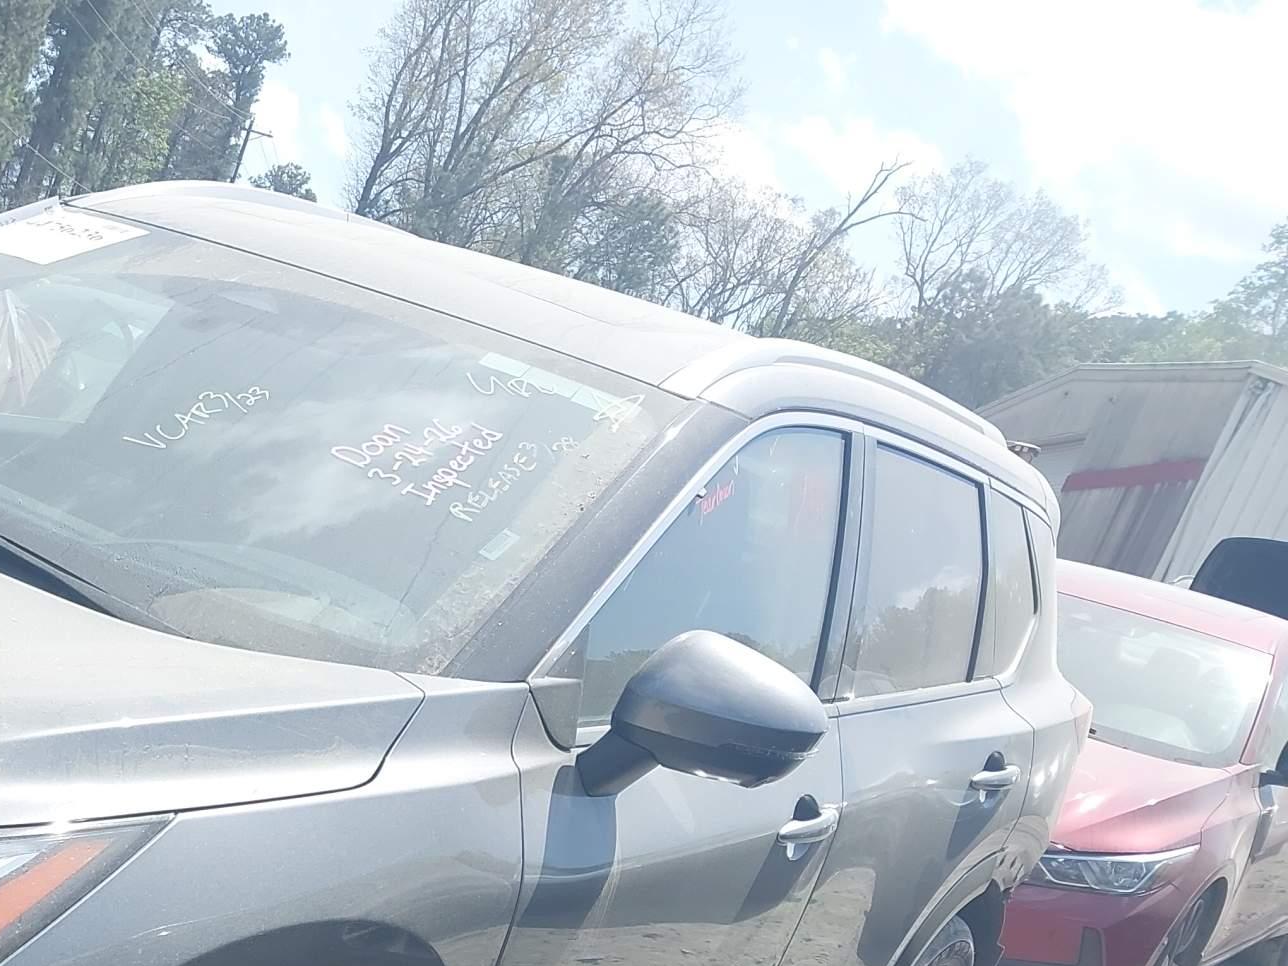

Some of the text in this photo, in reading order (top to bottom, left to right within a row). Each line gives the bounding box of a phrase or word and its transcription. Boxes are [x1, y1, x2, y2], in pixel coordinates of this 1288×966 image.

[330, 423, 412, 468] Doan
[367, 418, 463, 486] 3-24-26
[400, 421, 504, 506] Inspected
